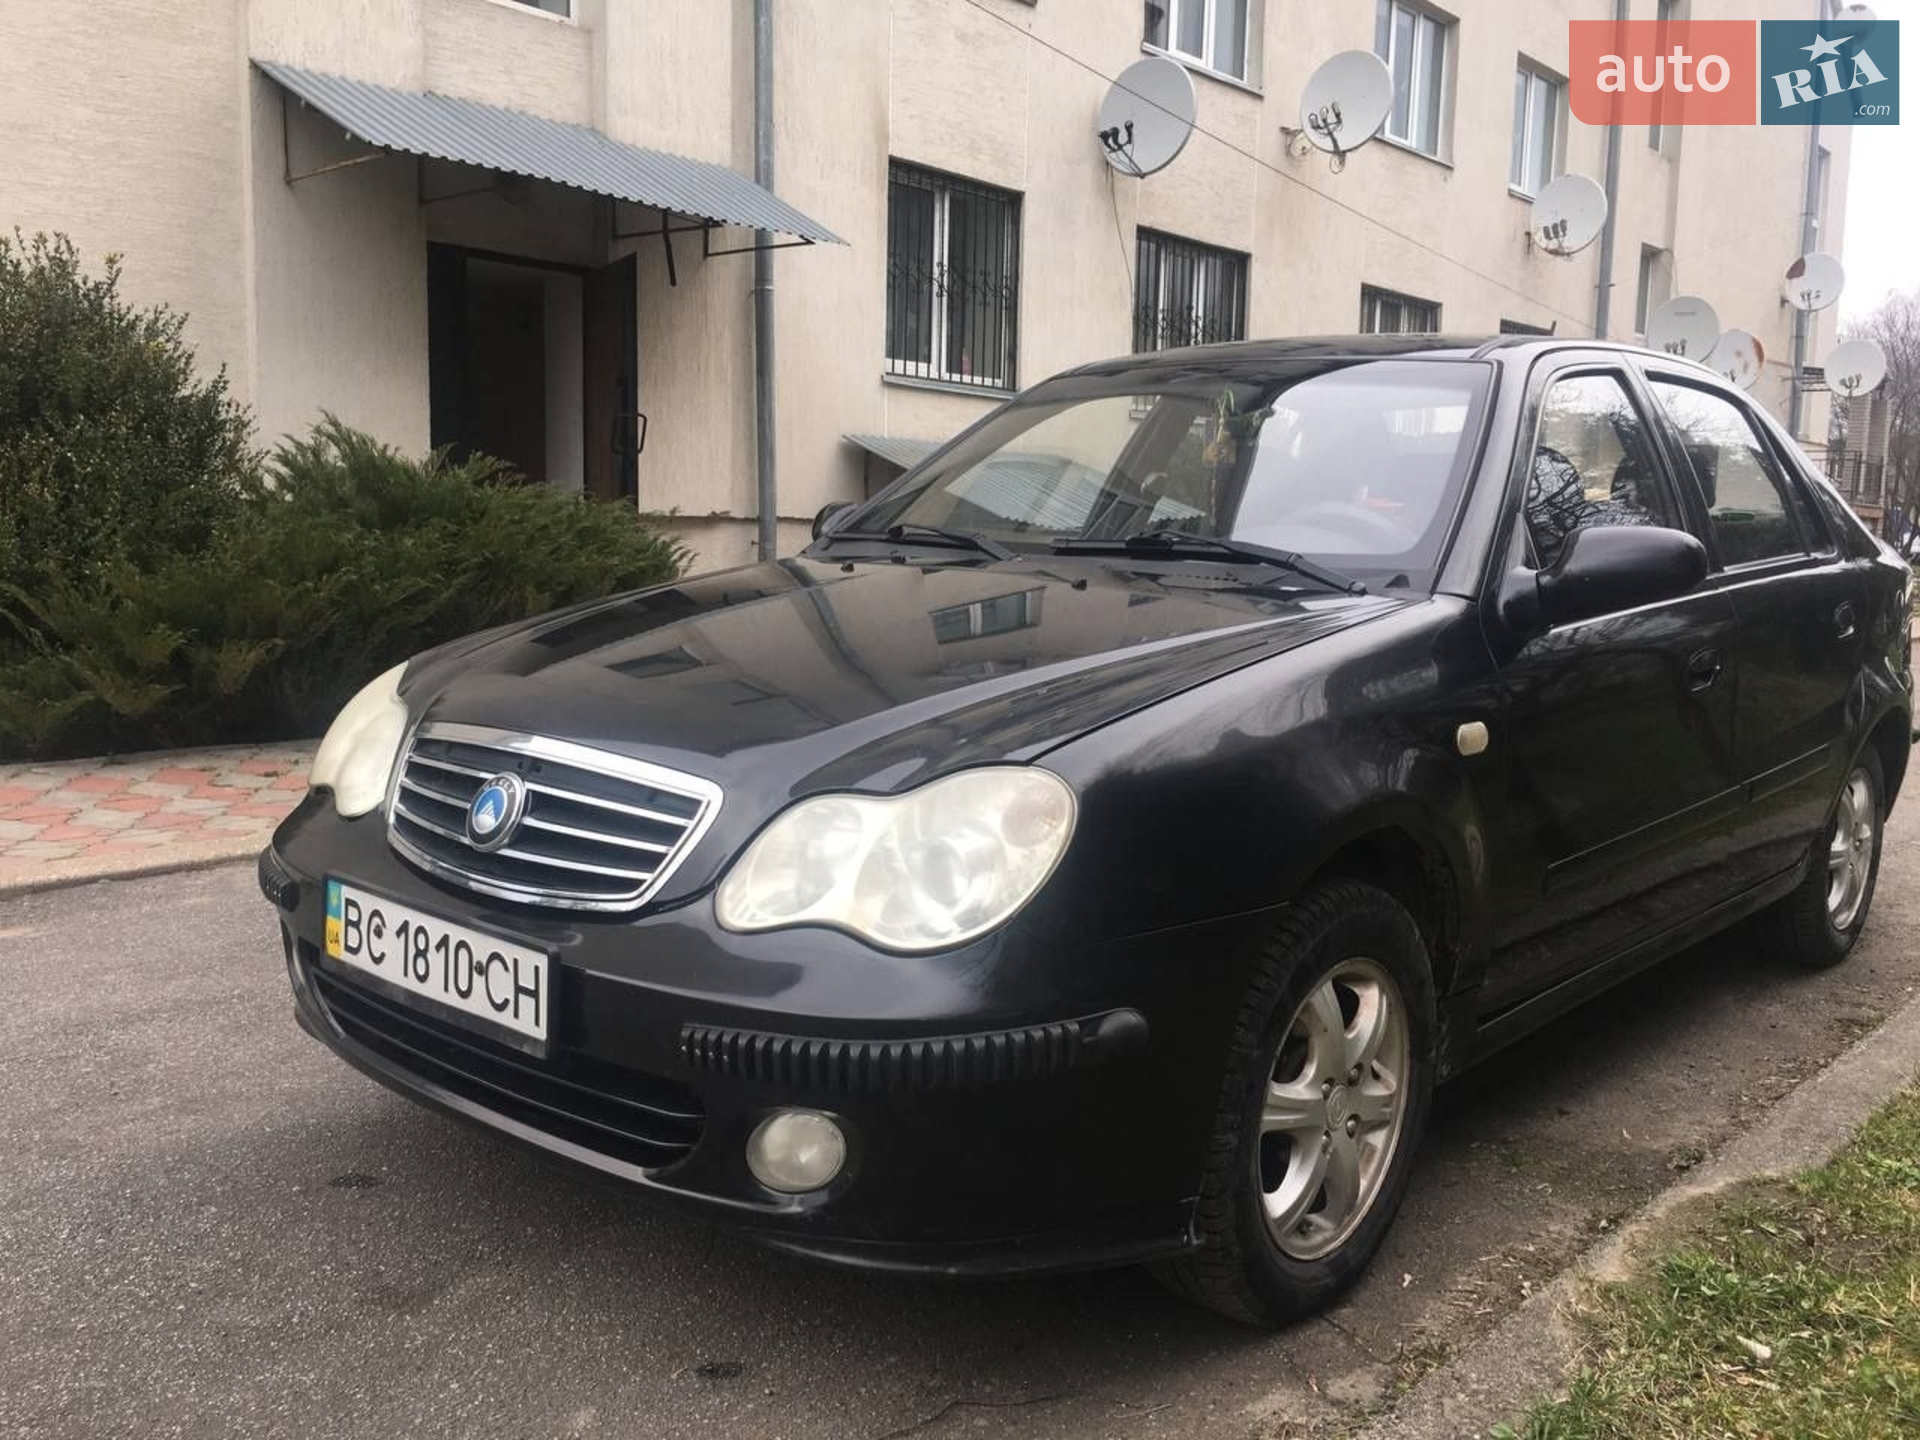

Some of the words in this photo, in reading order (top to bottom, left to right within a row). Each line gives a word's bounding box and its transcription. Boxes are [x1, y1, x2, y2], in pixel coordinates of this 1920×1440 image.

[328, 928, 340, 946] UA
[344, 897, 387, 965] BC
[395, 919, 474, 1000] 1810
[485, 951, 541, 1028] CH
